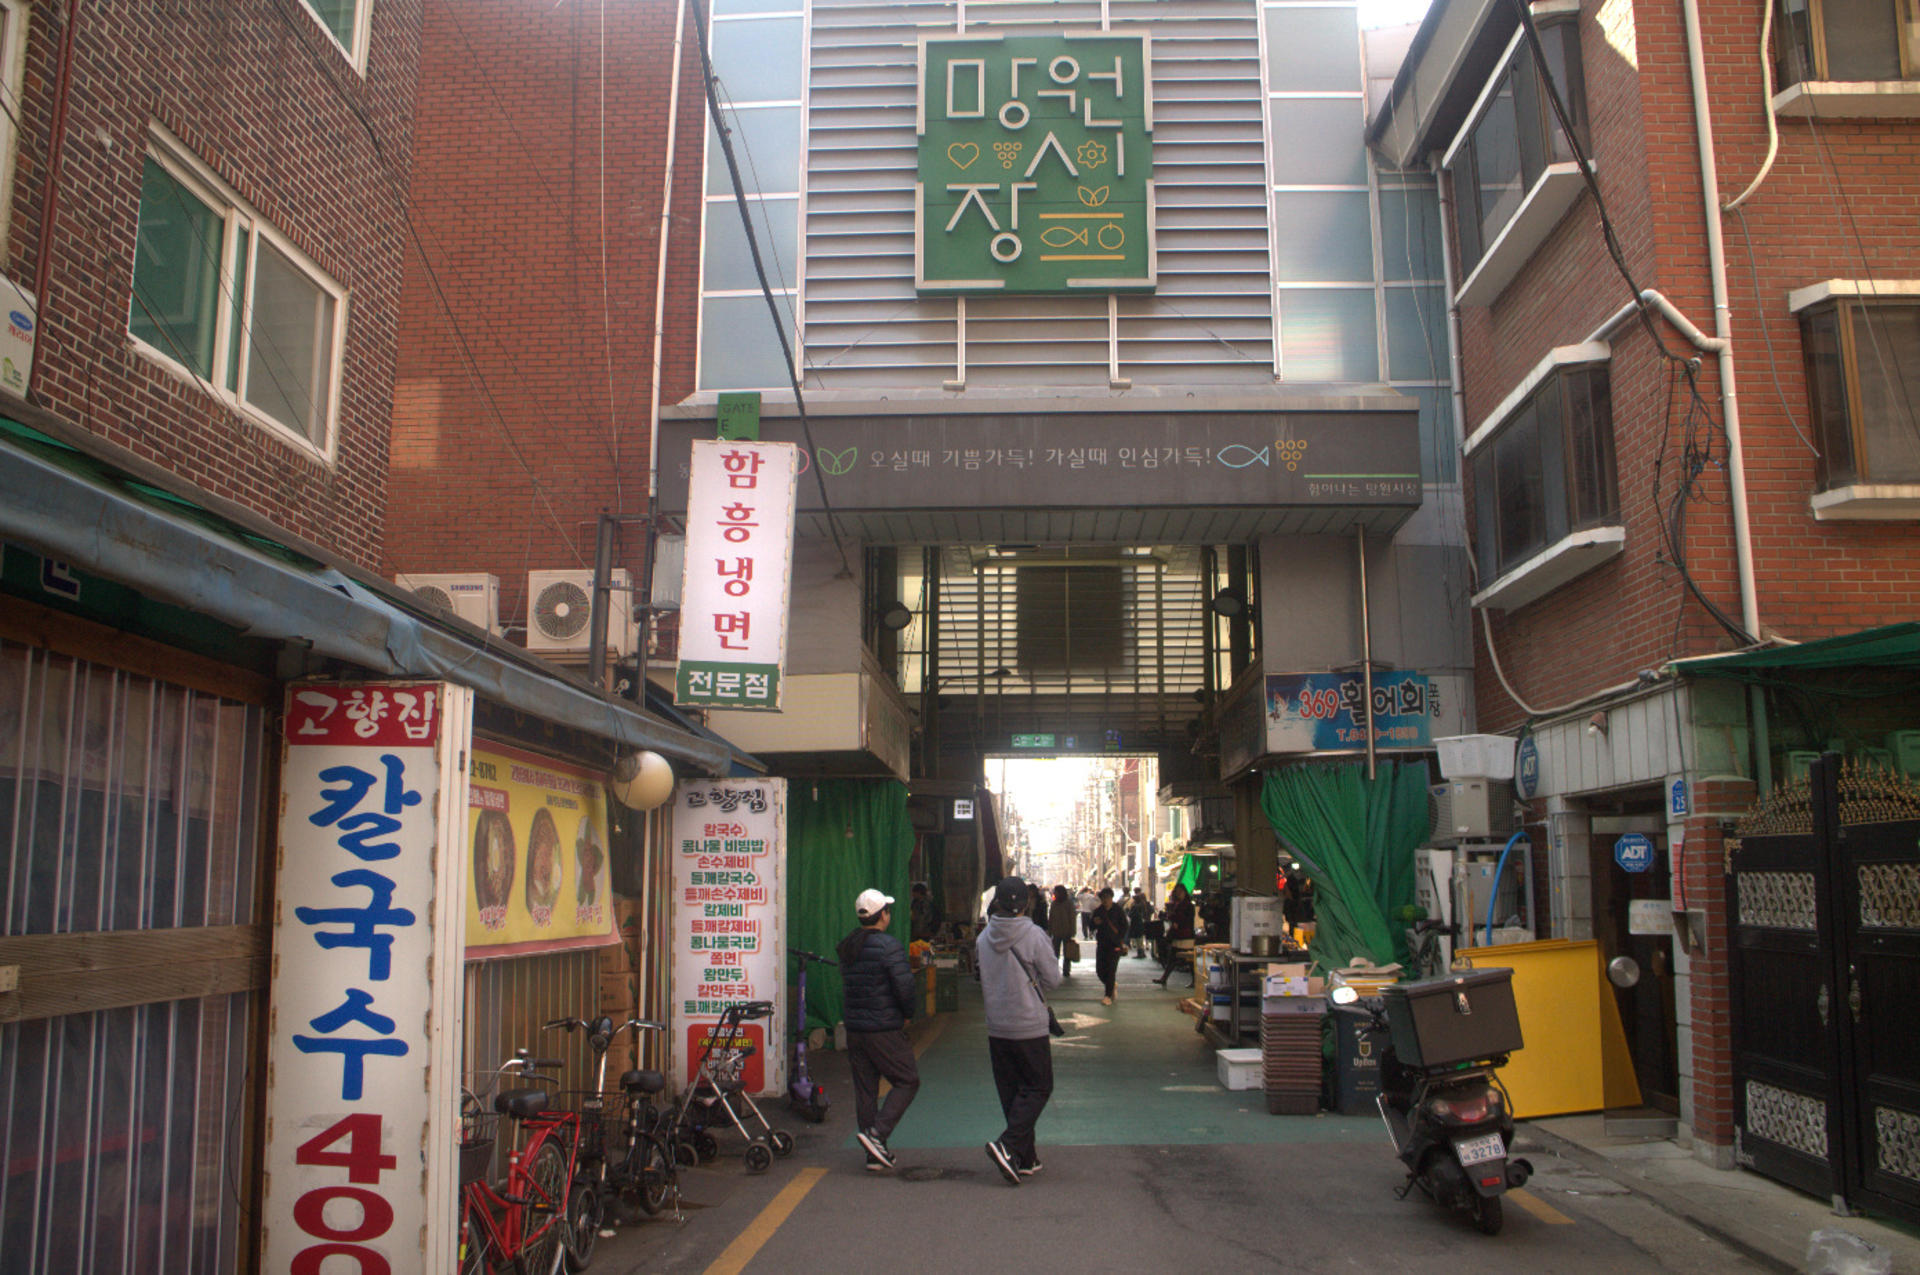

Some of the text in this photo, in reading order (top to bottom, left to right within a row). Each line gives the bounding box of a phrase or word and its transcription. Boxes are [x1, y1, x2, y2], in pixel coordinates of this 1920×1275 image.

[722, 403, 754, 414] GATE
[871, 447, 1211, 471] 오실때 기쁨가득! 가실때 인심가득!
[712, 449, 766, 651] 함흥냉면
[688, 670, 769, 699] 전문점
[1300, 678, 1424, 726] 369 활어회
[1428, 683, 1440, 718] 포장
[296, 690, 436, 739] 고향집
[1524, 755, 1535, 777] ADT
[687, 787, 768, 812] 고향집
[704, 823, 742, 837] 칼국수
[682, 839, 764, 853] 콩나물 비빔밥
[1622, 845, 1648, 860] ADT
[698, 856, 749, 869] 손수제비
[691, 872, 756, 886] 들깨칼국수
[685, 888, 763, 901] 들깨손수제비
[704, 904, 743, 917] 칼제비
[292, 754, 422, 1101] 칼국수
[691, 920, 756, 934] 들깨칼제비
[690, 936, 756, 950] 콩나물국밥
[710, 952, 736, 966] 쫄면
[704, 969, 743, 982] 왕만두
